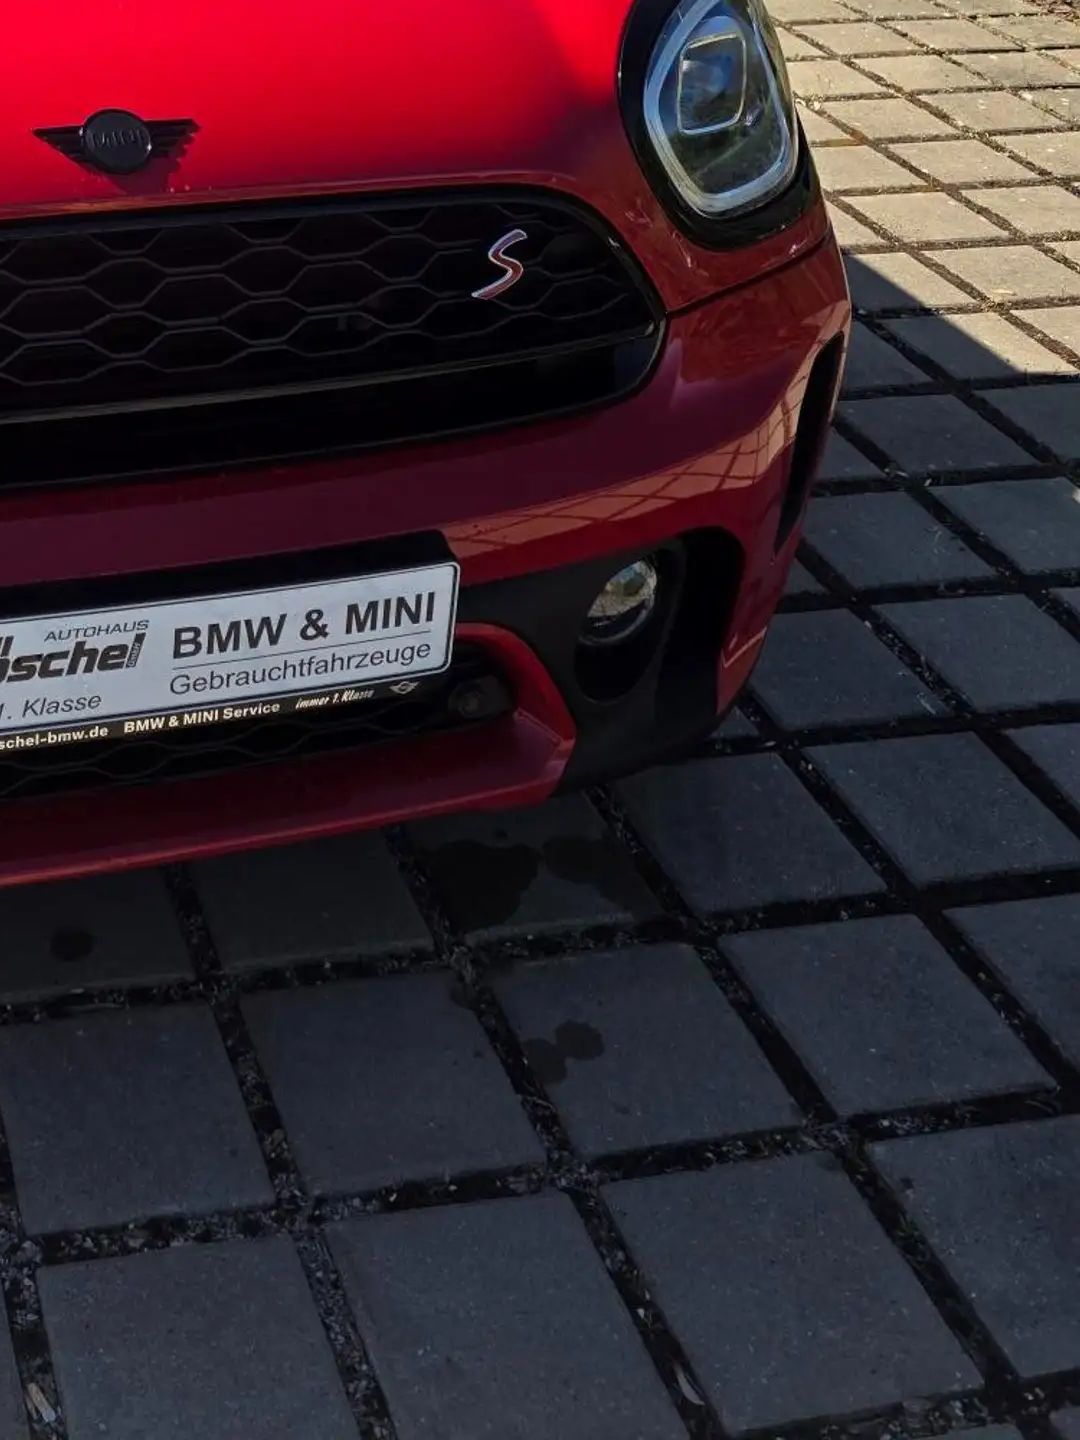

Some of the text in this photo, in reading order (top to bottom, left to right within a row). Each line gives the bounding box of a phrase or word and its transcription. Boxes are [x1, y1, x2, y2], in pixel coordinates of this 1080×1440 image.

[471, 228, 528, 301] S
[44, 619, 150, 643] AUTOHAUS
[172, 591, 436, 660] BMW & MINI
[170, 643, 432, 695] Gebrauchtfahrzeuge
[22, 694, 102, 718] Klasse
[123, 702, 281, 734] BMW & MINI Service
